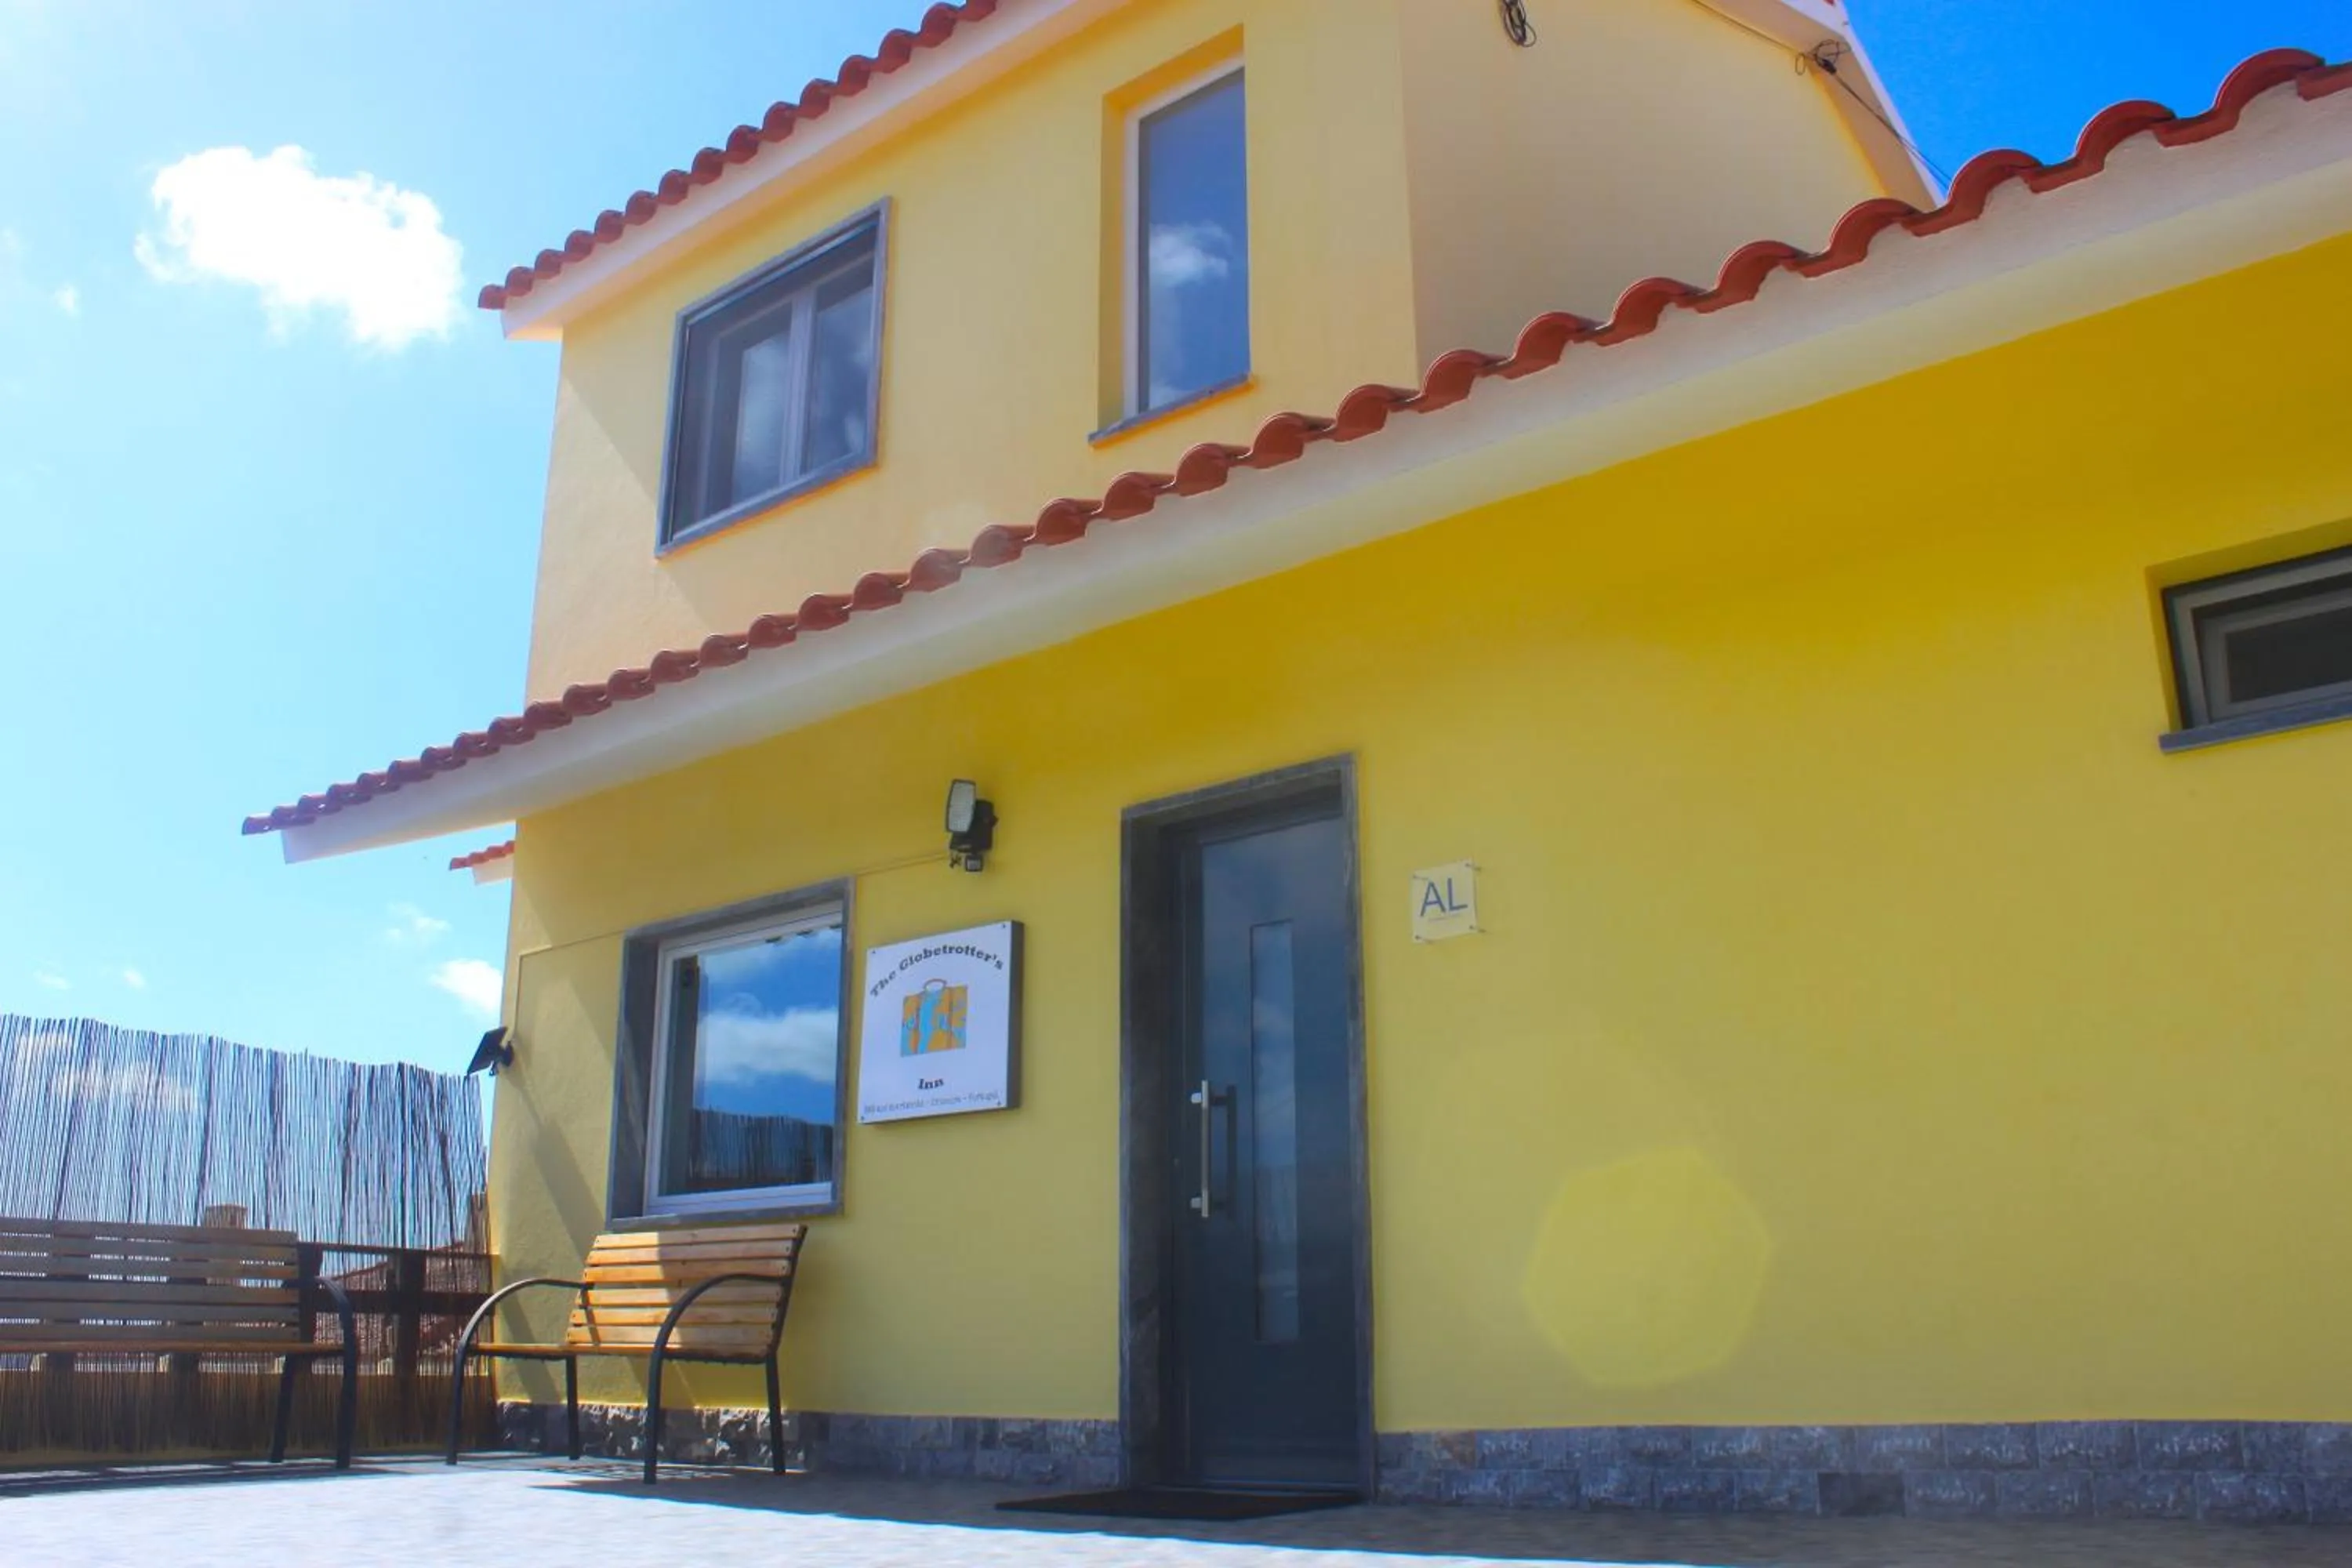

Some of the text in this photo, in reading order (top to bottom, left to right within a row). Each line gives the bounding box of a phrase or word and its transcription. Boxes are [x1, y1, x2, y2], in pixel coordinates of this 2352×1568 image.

[1420, 877, 1468, 916] AL
[870, 944, 1004, 997] The Globetrotter's
[918, 1078, 944, 1090] Inn
